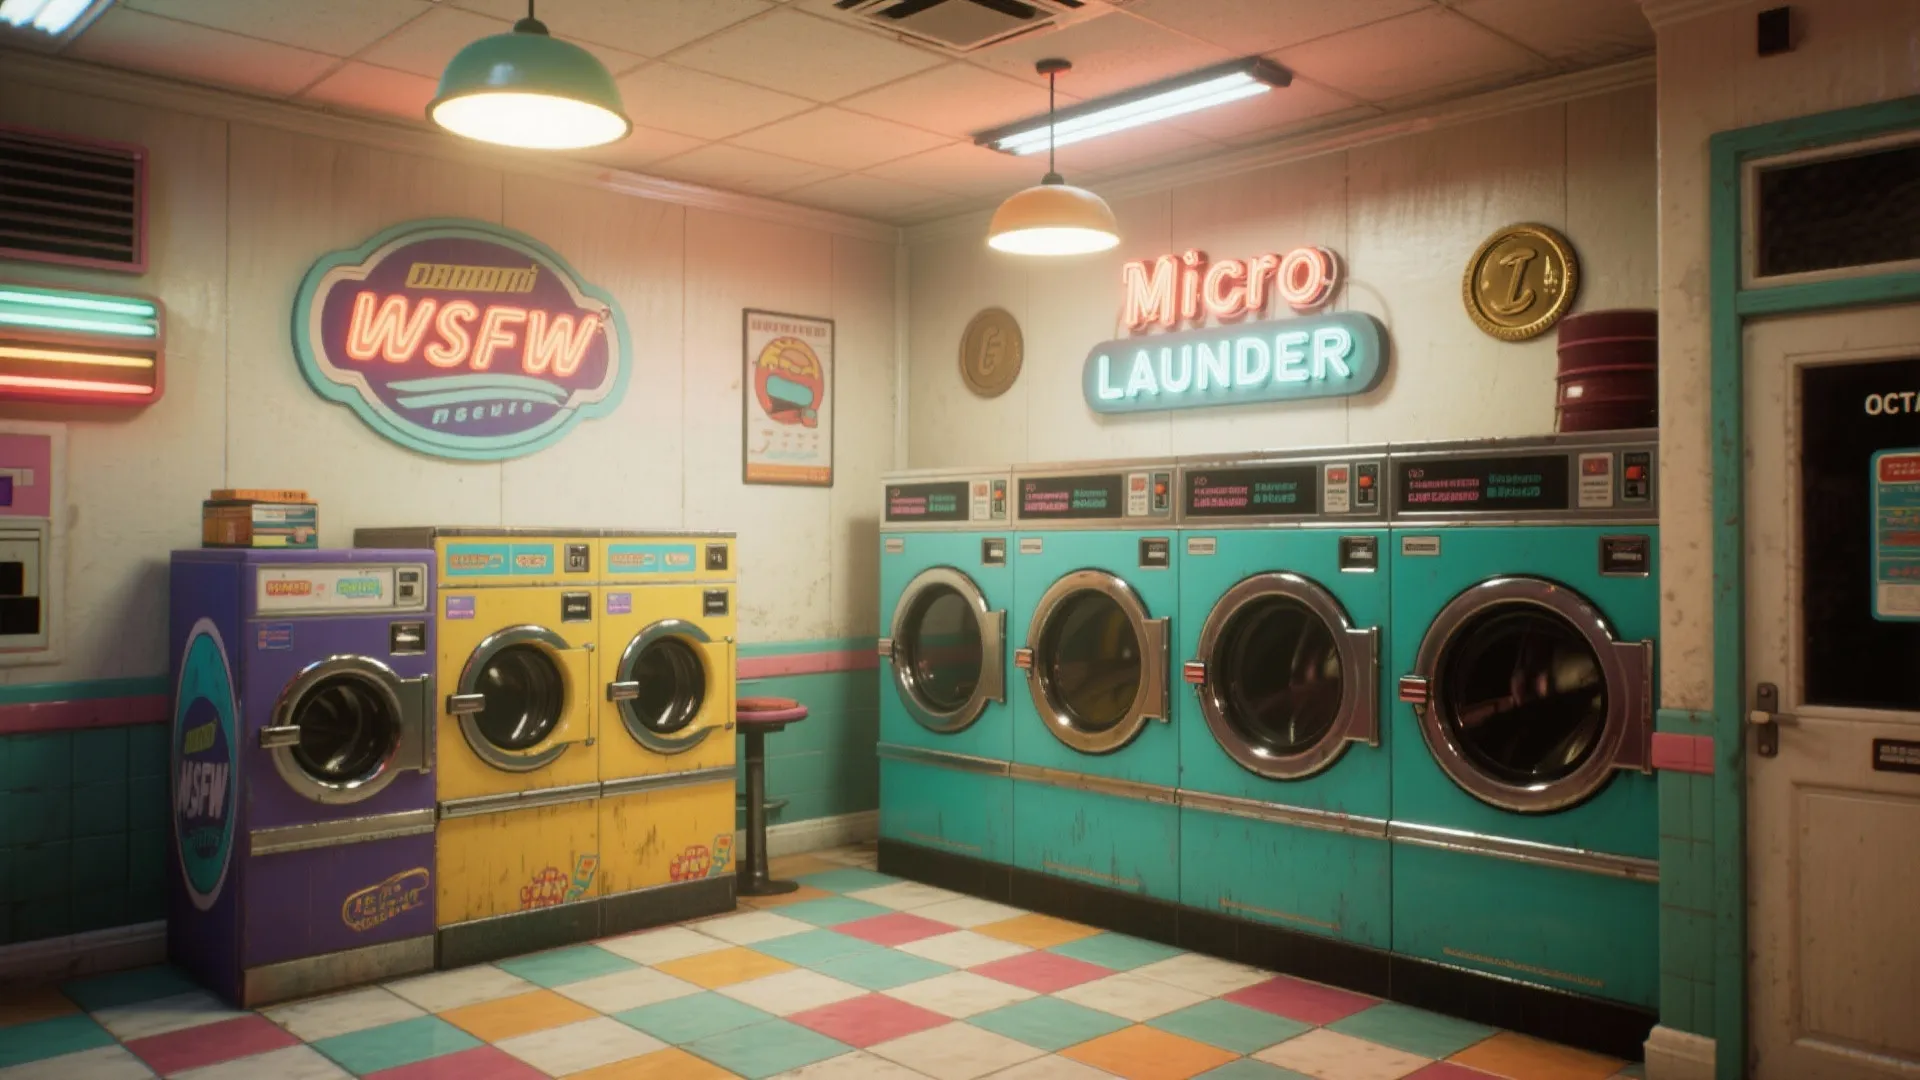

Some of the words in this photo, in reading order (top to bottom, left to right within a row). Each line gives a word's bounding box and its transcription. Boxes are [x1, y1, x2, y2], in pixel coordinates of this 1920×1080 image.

[1123, 246, 1332, 329] Micro
[346, 291, 600, 377] WSFW
[1097, 326, 1353, 400] LAUNDER
